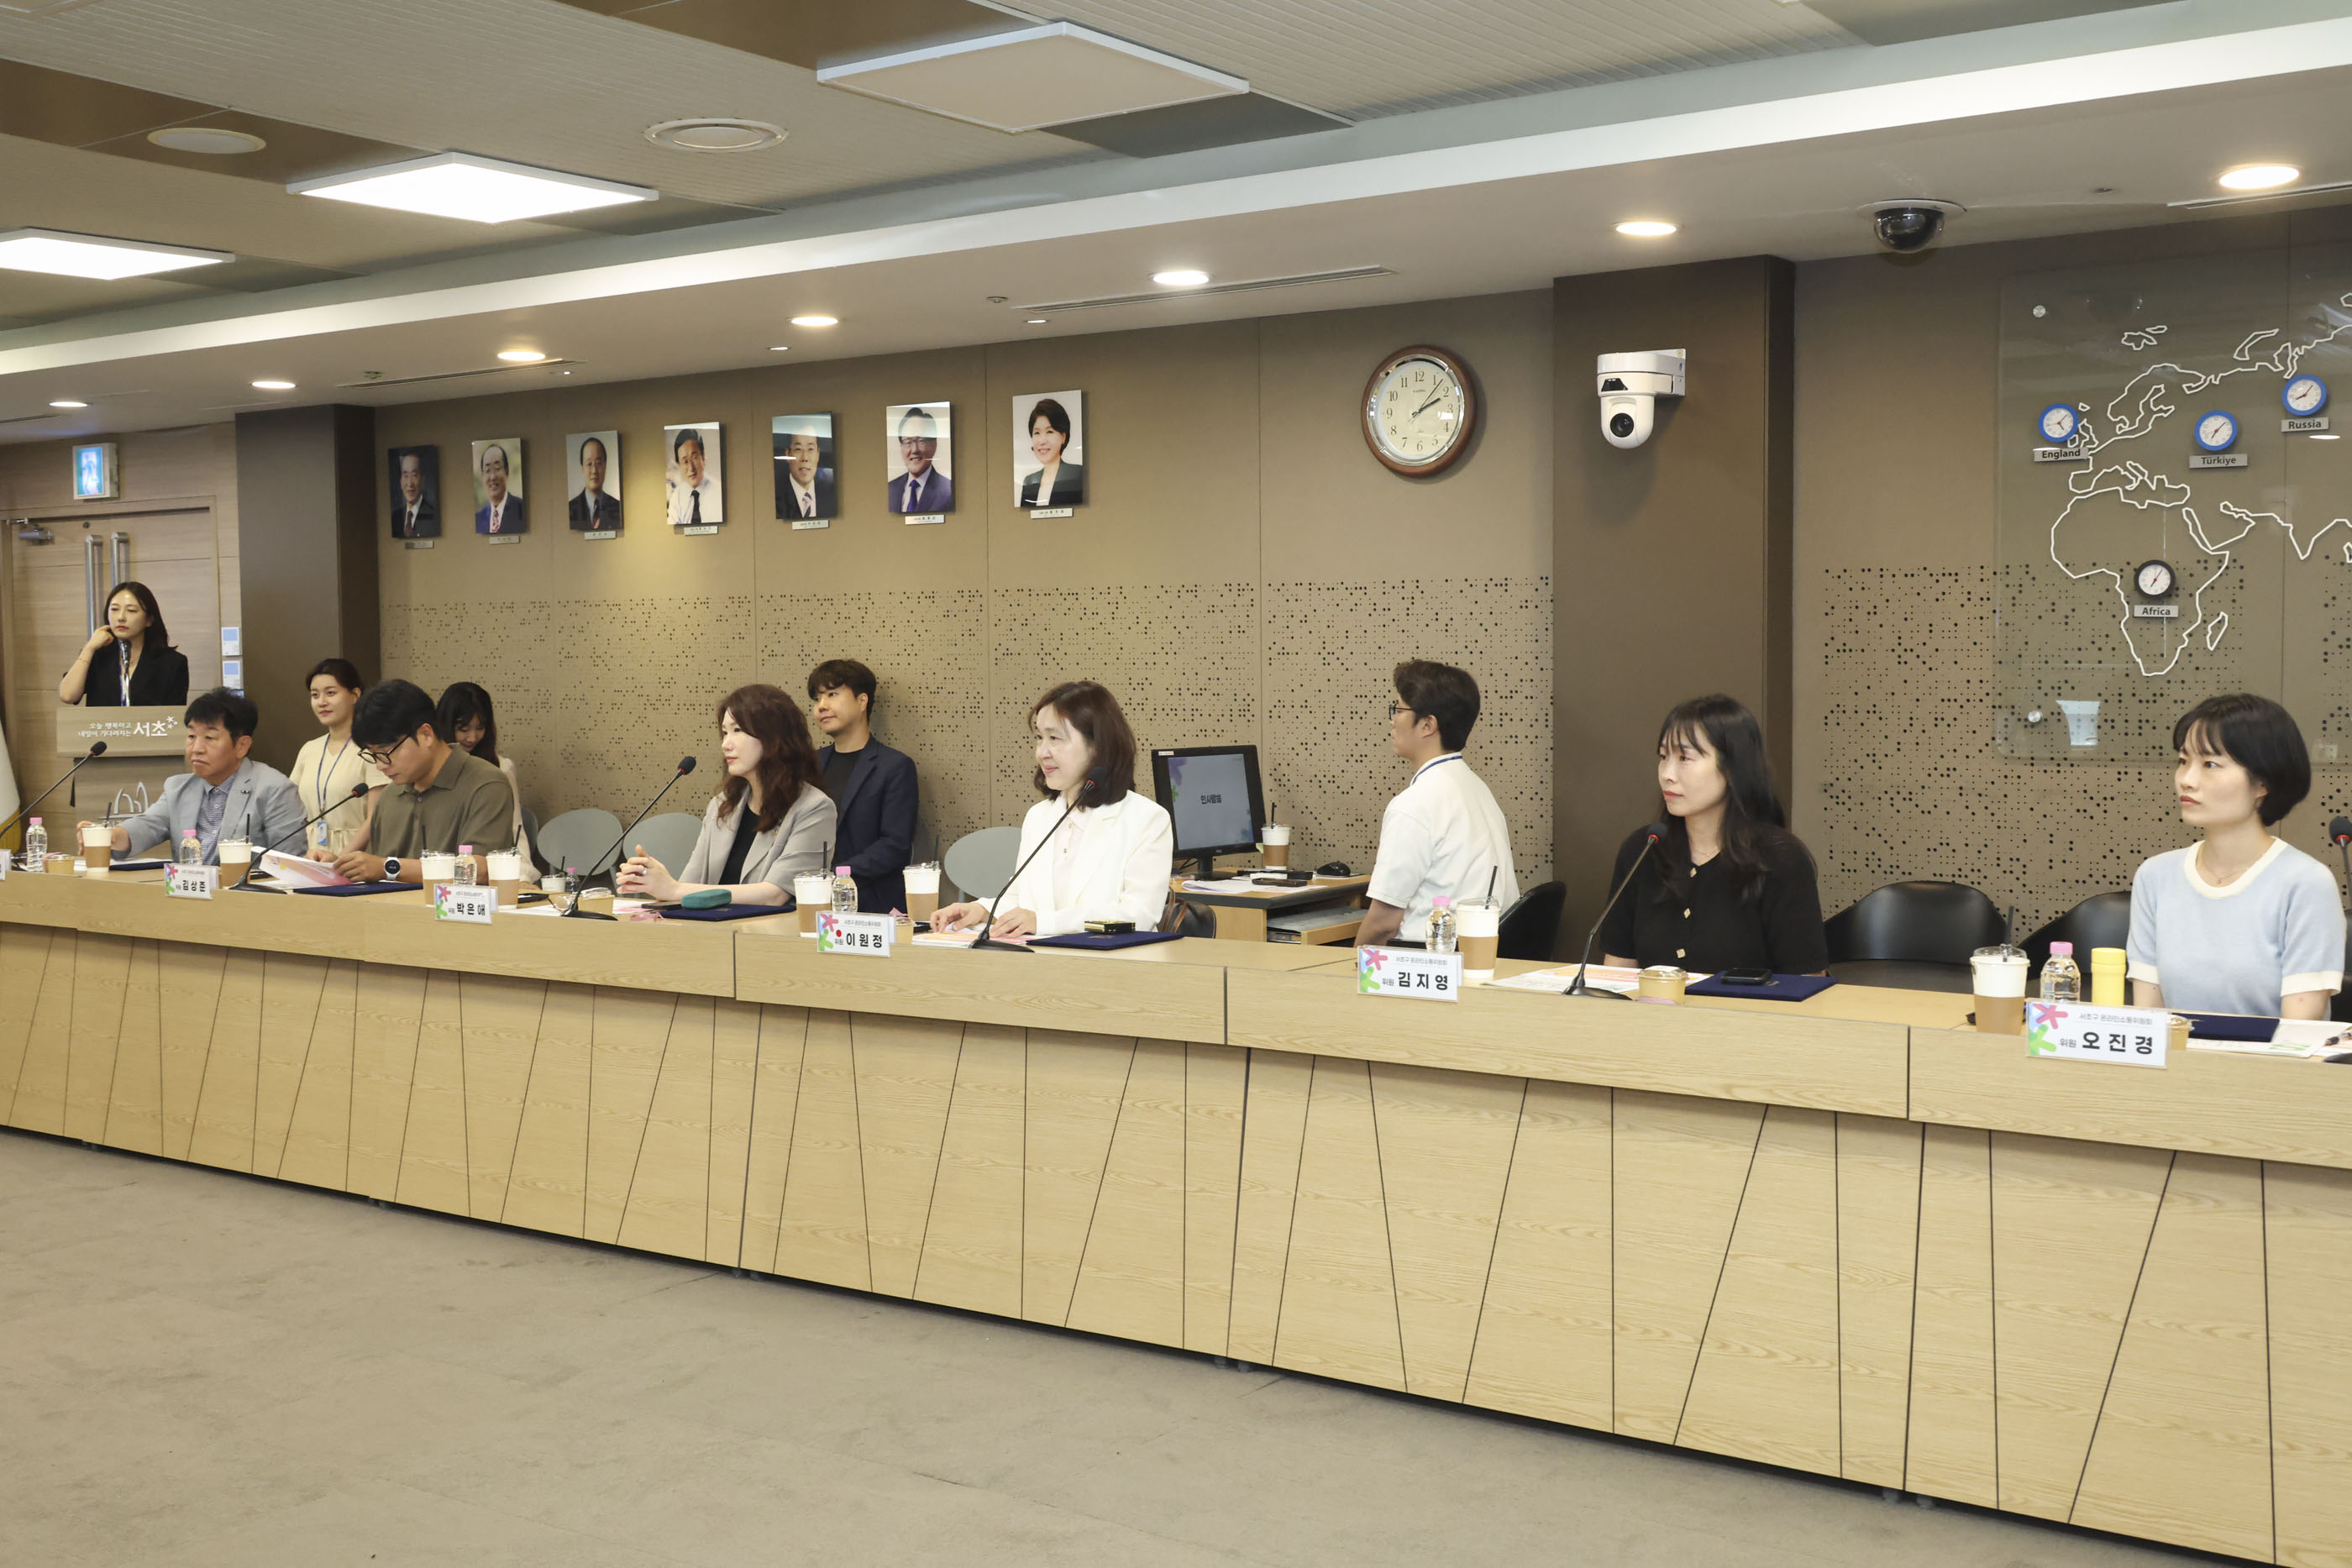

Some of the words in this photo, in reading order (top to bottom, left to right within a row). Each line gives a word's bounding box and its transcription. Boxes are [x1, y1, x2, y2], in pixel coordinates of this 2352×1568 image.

[1415, 371, 1425, 382] 12
[1401, 377, 1408, 388] 11
[1389, 391, 1398, 401] 10
[1443, 386, 1449, 397] 2
[1386, 408, 1393, 419] 9
[1390, 425, 1397, 435] 8
[1444, 422, 1449, 433] 4
[2288, 420, 2322, 429] Russia
[1402, 437, 1408, 448] 7
[1416, 440, 1423, 452] 6
[1431, 435, 1438, 446] 5
[2041, 448, 2081, 459] England
[2201, 456, 2236, 466] Türkiye
[2142, 607, 2171, 616] Africa
[134, 721, 168, 737] 서초
[846, 933, 882, 948] 이원정
[1382, 978, 1394, 986] 위원
[1398, 972, 1448, 990] 김지영
[2060, 1038, 2076, 1048] 위원
[2082, 1031, 2153, 1055] 오진경
